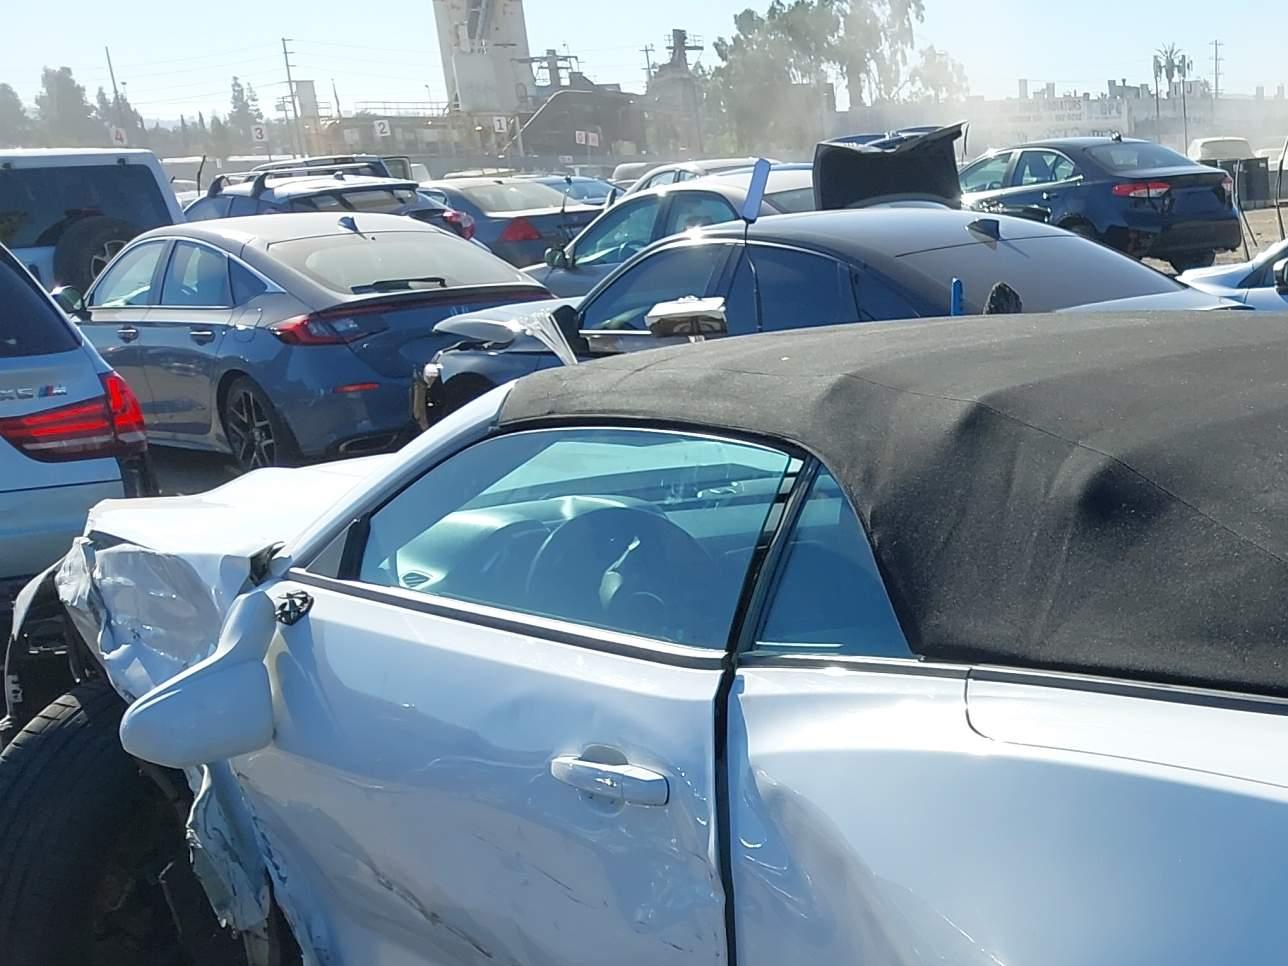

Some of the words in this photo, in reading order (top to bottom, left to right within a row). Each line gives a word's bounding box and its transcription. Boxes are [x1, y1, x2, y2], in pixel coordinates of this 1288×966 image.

[378, 122, 388, 134] 2
[496, 119, 504, 130] 1
[115, 130, 124, 143] 4
[256, 128, 264, 139] 3
